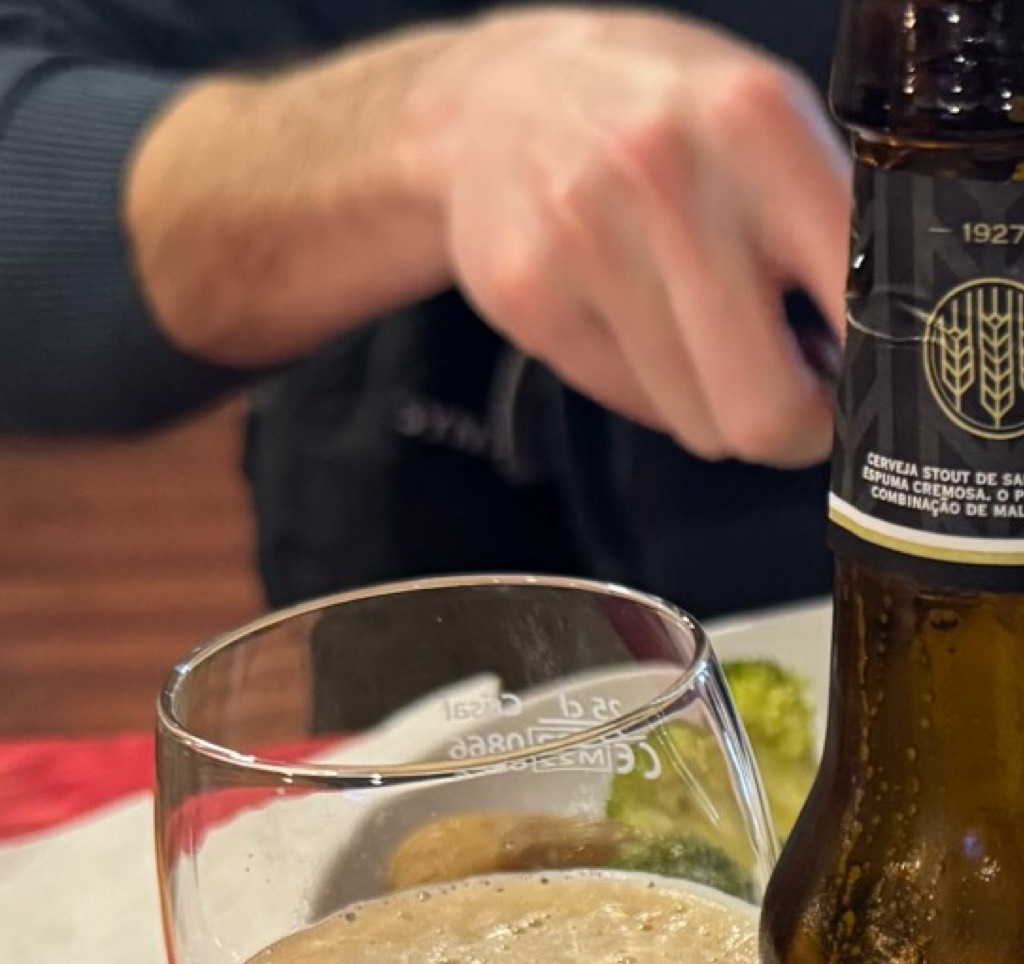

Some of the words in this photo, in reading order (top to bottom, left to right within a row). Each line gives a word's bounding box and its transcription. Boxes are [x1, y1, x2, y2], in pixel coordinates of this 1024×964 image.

[862, 465, 909, 492] ESPUMA
[996, 487, 1009, 502] O
[867, 451, 918, 477] CERVEJA
[922, 466, 971, 484] STOUT
[975, 471, 998, 486] DE
[871, 485, 961, 518] COMBINAÇÃO
[965, 503, 988, 518] DE
